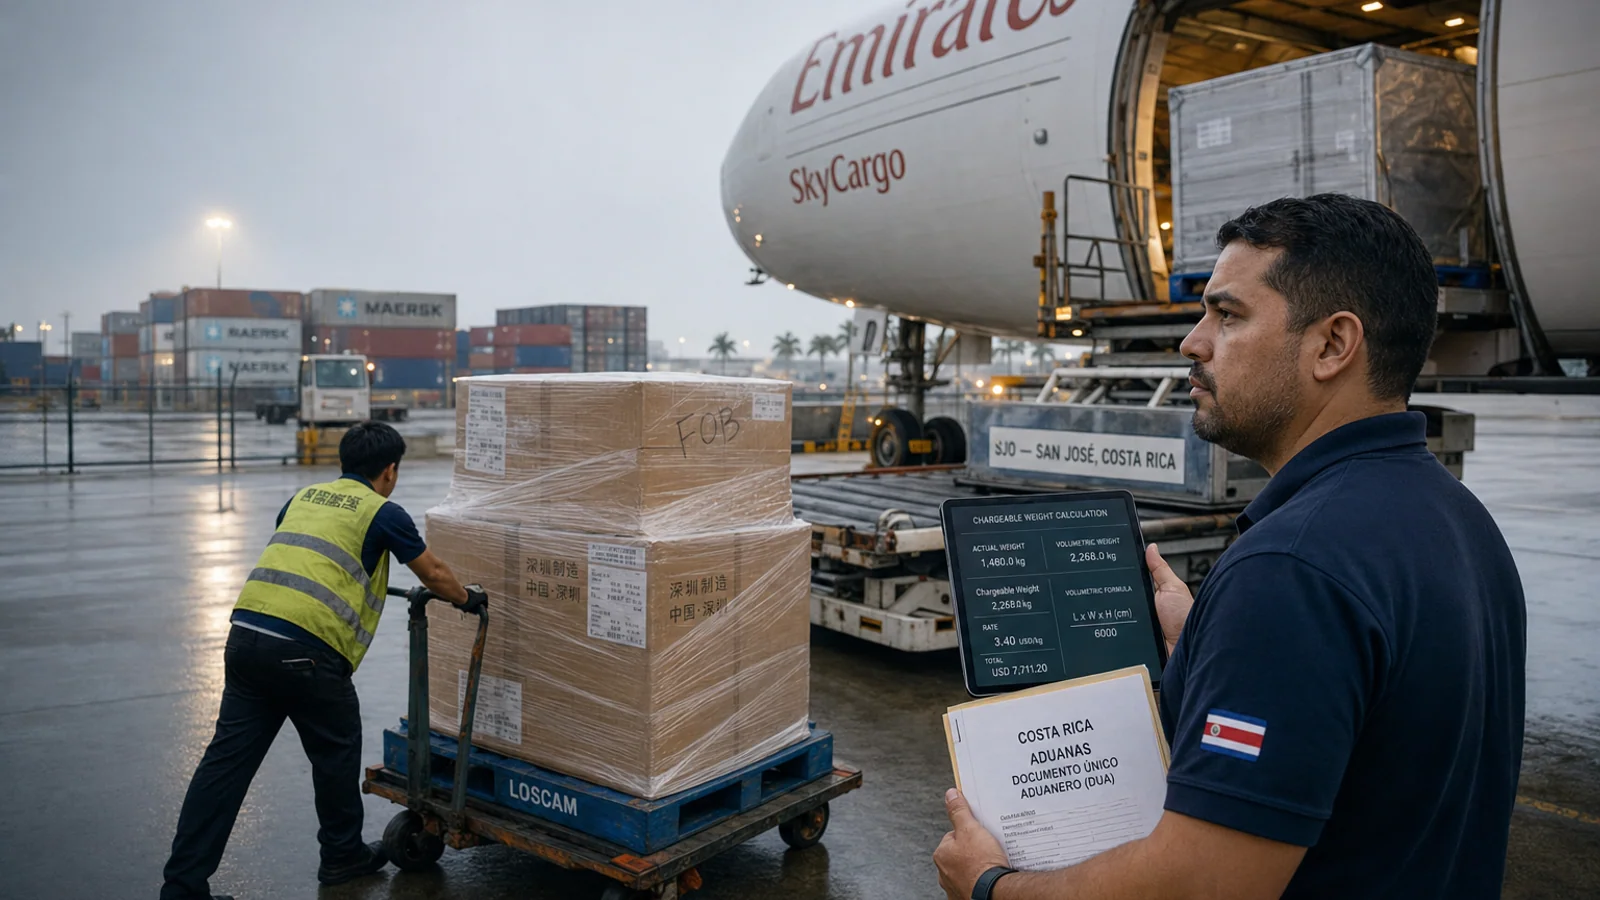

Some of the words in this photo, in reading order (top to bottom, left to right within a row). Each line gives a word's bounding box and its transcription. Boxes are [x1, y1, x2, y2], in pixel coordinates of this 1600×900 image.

[791, 0, 1076, 114] Emirat
[789, 148, 906, 207] SkyCargo
[365, 300, 443, 318] MAERSK
[676, 406, 740, 459] FOB
[995, 440, 1016, 457] SJO
[1036, 443, 1060, 461] SAN
[1064, 443, 1098, 467] JOSÉ,
[1101, 448, 1142, 468] COSTA
[1146, 451, 1176, 470] RICA
[972, 513, 1023, 525] CHARGEABLE
[1024, 512, 1053, 521] WEIGHT
[1055, 509, 1108, 520] CALCULATION
[999, 542, 1025, 551] WEIGHT
[1056, 539, 1095, 548] VOLUMETRIC
[1096, 537, 1120, 546] WEIGHT
[1015, 556, 1026, 568] kg
[1070, 551, 1105, 563] 2,268.0
[1106, 551, 1117, 561] kg
[670, 574, 728, 599] 深圳制造
[975, 586, 1015, 598] Chargeable
[1015, 584, 1040, 595] Weight
[1065, 587, 1103, 596] VOLUMETRIC
[1104, 585, 1132, 594] FORMULA
[1022, 600, 1033, 610] kg
[1072, 612, 1079, 622] L
[1087, 610, 1096, 620] W
[1105, 609, 1112, 619] H
[1114, 608, 1133, 620] (cm)
[982, 623, 999, 632] RATE
[1094, 627, 1118, 638] 6000
[994, 635, 1016, 647] 3.40
[985, 657, 1004, 665] TOTAL
[991, 666, 1010, 677] USD
[1012, 663, 1048, 676] 7,711.20
[1017, 725, 1061, 744] COSTA
[1062, 718, 1094, 736] RICA
[1030, 742, 1092, 766] ADUANAS
[1012, 763, 1082, 786] DOCUMENTO
[1083, 756, 1119, 773] ÚNICO
[1020, 779, 1082, 800] ADUANERO
[1084, 773, 1115, 790] (DUA)
[509, 779, 578, 816] LOSCAM
